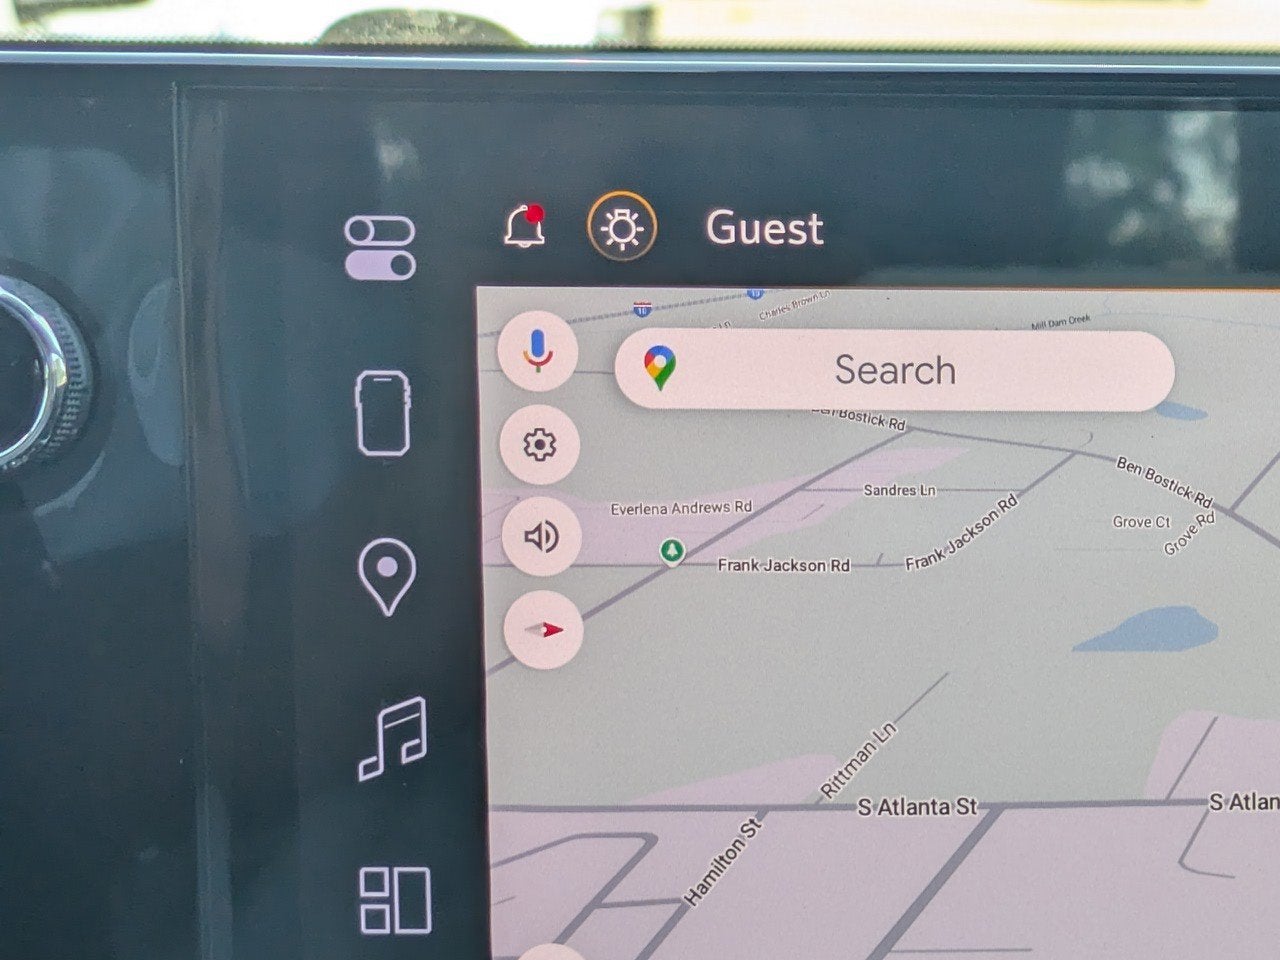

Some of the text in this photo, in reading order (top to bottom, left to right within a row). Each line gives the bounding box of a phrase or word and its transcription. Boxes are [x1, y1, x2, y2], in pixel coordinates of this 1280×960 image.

[706, 209, 825, 246] Guest
[759, 303, 791, 321] Charles
[791, 294, 818, 311] Brown
[1031, 313, 1091, 331] Mill Dam Creek
[834, 353, 957, 386] Search
[839, 409, 886, 428] Bostick
[888, 417, 906, 432] Rd
[863, 483, 936, 497] Sandres Ln
[1116, 456, 1214, 510] Ben Bostick Rd
[610, 499, 753, 517] Everlena Andrews Rd
[905, 492, 1019, 571] Frank Jackson Rd
[1112, 514, 1171, 529] Grove Ct
[1163, 511, 1216, 557] Grove Rd
[717, 557, 851, 574] Frank Jackson Rd
[819, 721, 897, 800] Rittman Ln
[857, 797, 978, 816] S Atlanta St
[1209, 792, 1224, 812] S
[684, 817, 763, 908] Hamilton St
